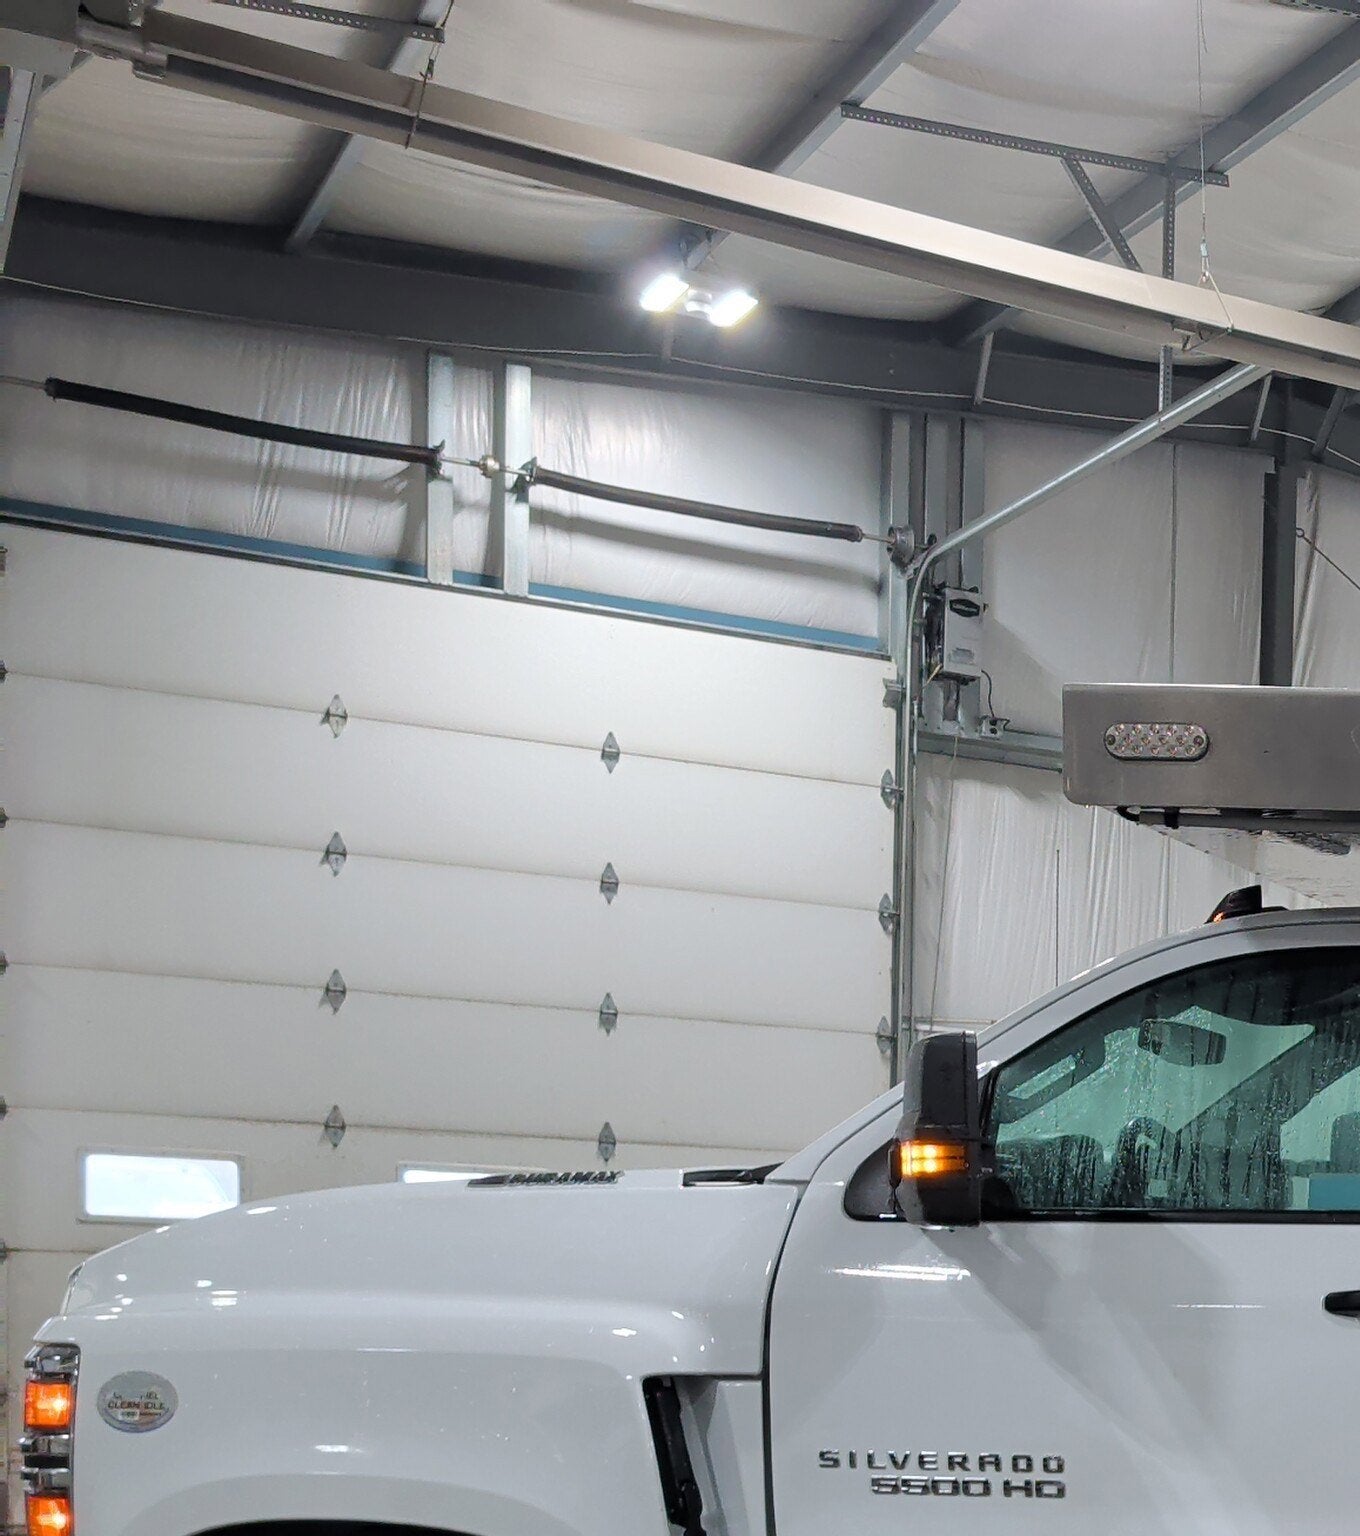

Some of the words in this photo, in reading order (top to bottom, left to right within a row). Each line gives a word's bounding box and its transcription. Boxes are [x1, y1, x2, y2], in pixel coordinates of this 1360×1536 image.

[818, 1448, 1066, 1474] SILVERADO
[870, 1474, 992, 1497] 5500
[1003, 1479, 1067, 1499] HD
